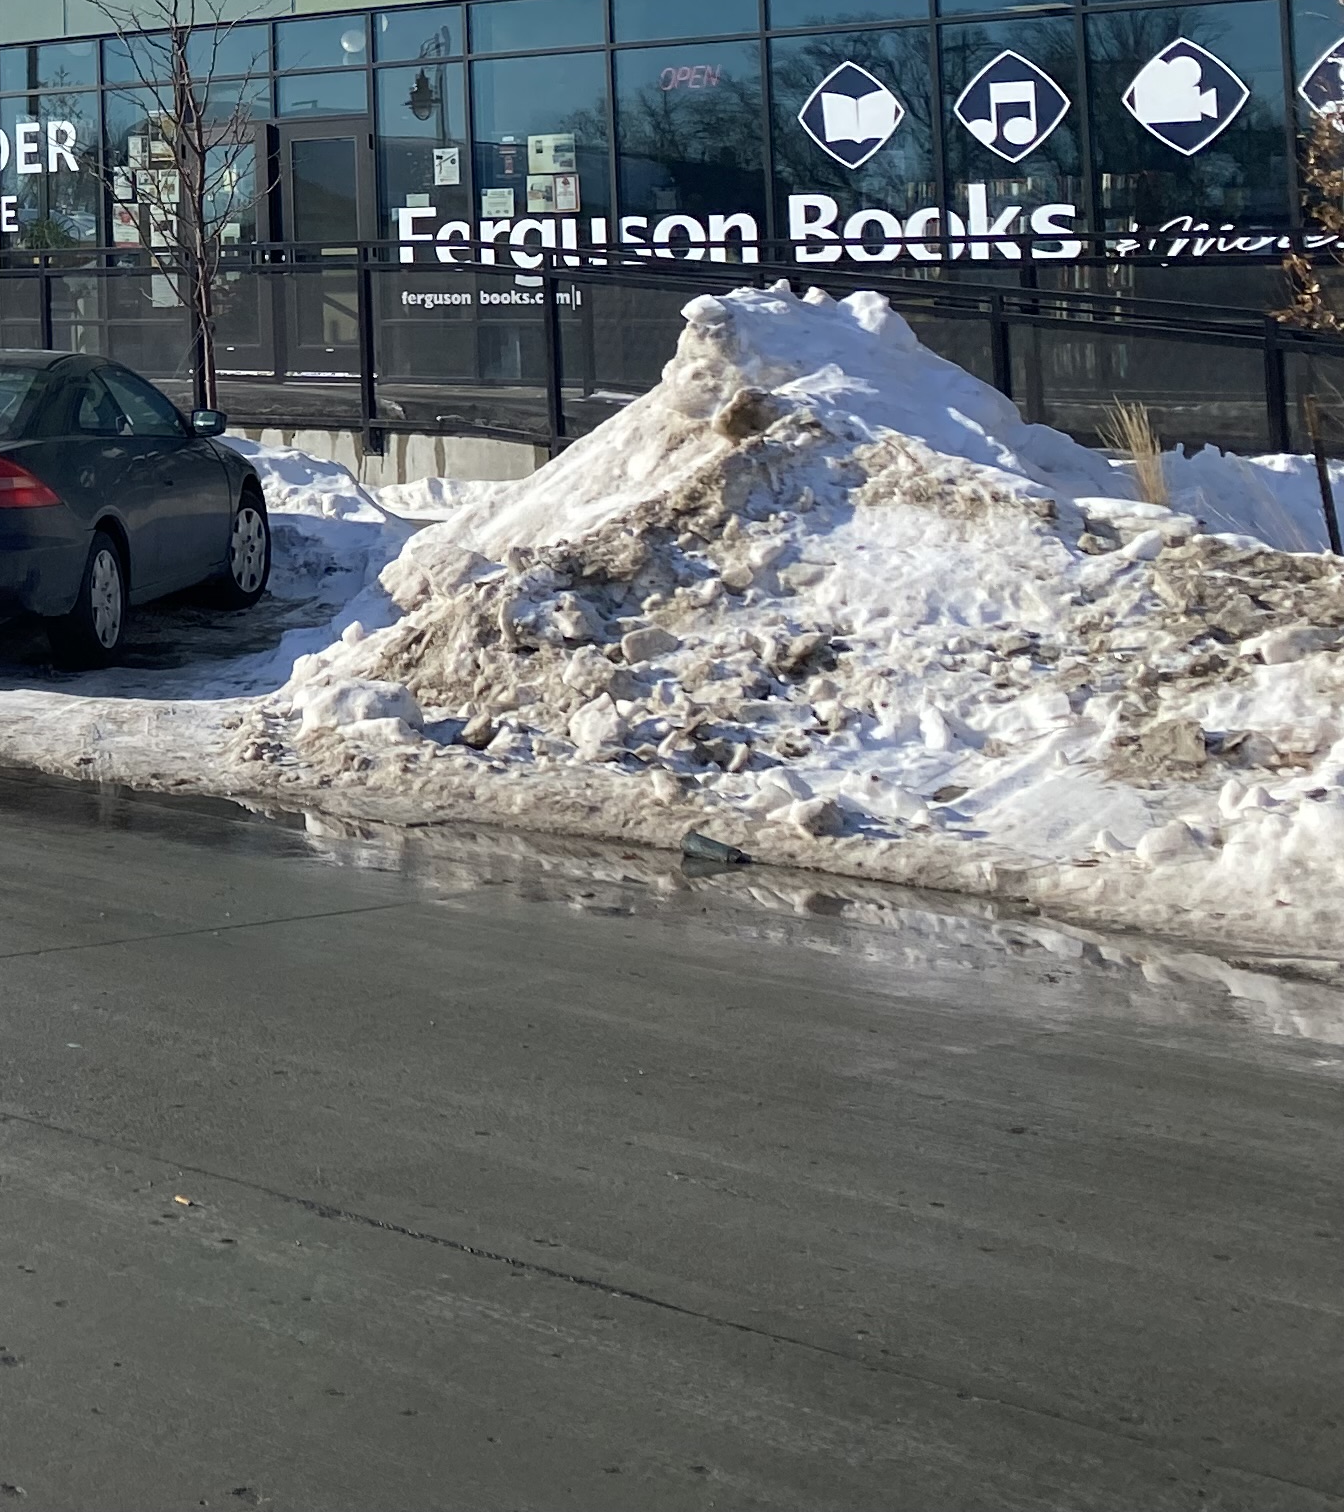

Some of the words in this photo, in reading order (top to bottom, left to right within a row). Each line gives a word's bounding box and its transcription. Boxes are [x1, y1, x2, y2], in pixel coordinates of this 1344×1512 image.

[660, 64, 721, 91] OPEN
[396, 206, 760, 287] Ferguson
[788, 184, 1082, 262] Books
